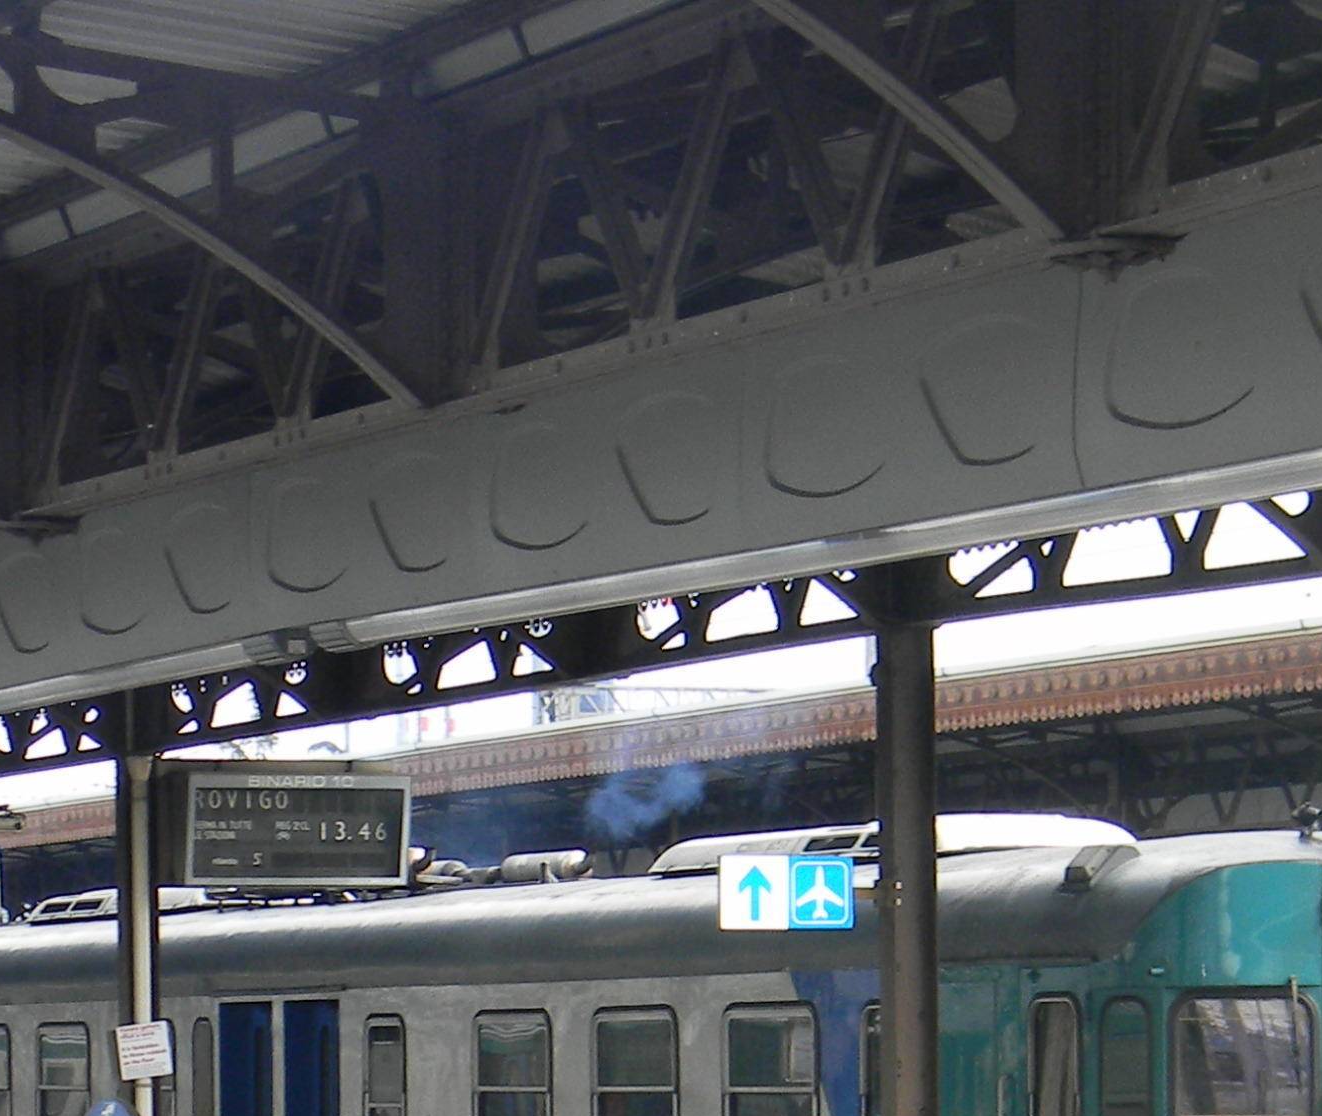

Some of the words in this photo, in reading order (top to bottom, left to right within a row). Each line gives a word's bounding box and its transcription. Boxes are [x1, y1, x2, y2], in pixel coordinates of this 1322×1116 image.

[247, 775, 327, 789] BINARIO
[330, 776, 355, 788] 10
[195, 789, 289, 810] ROVIGO
[320, 820, 387, 842] 13.46
